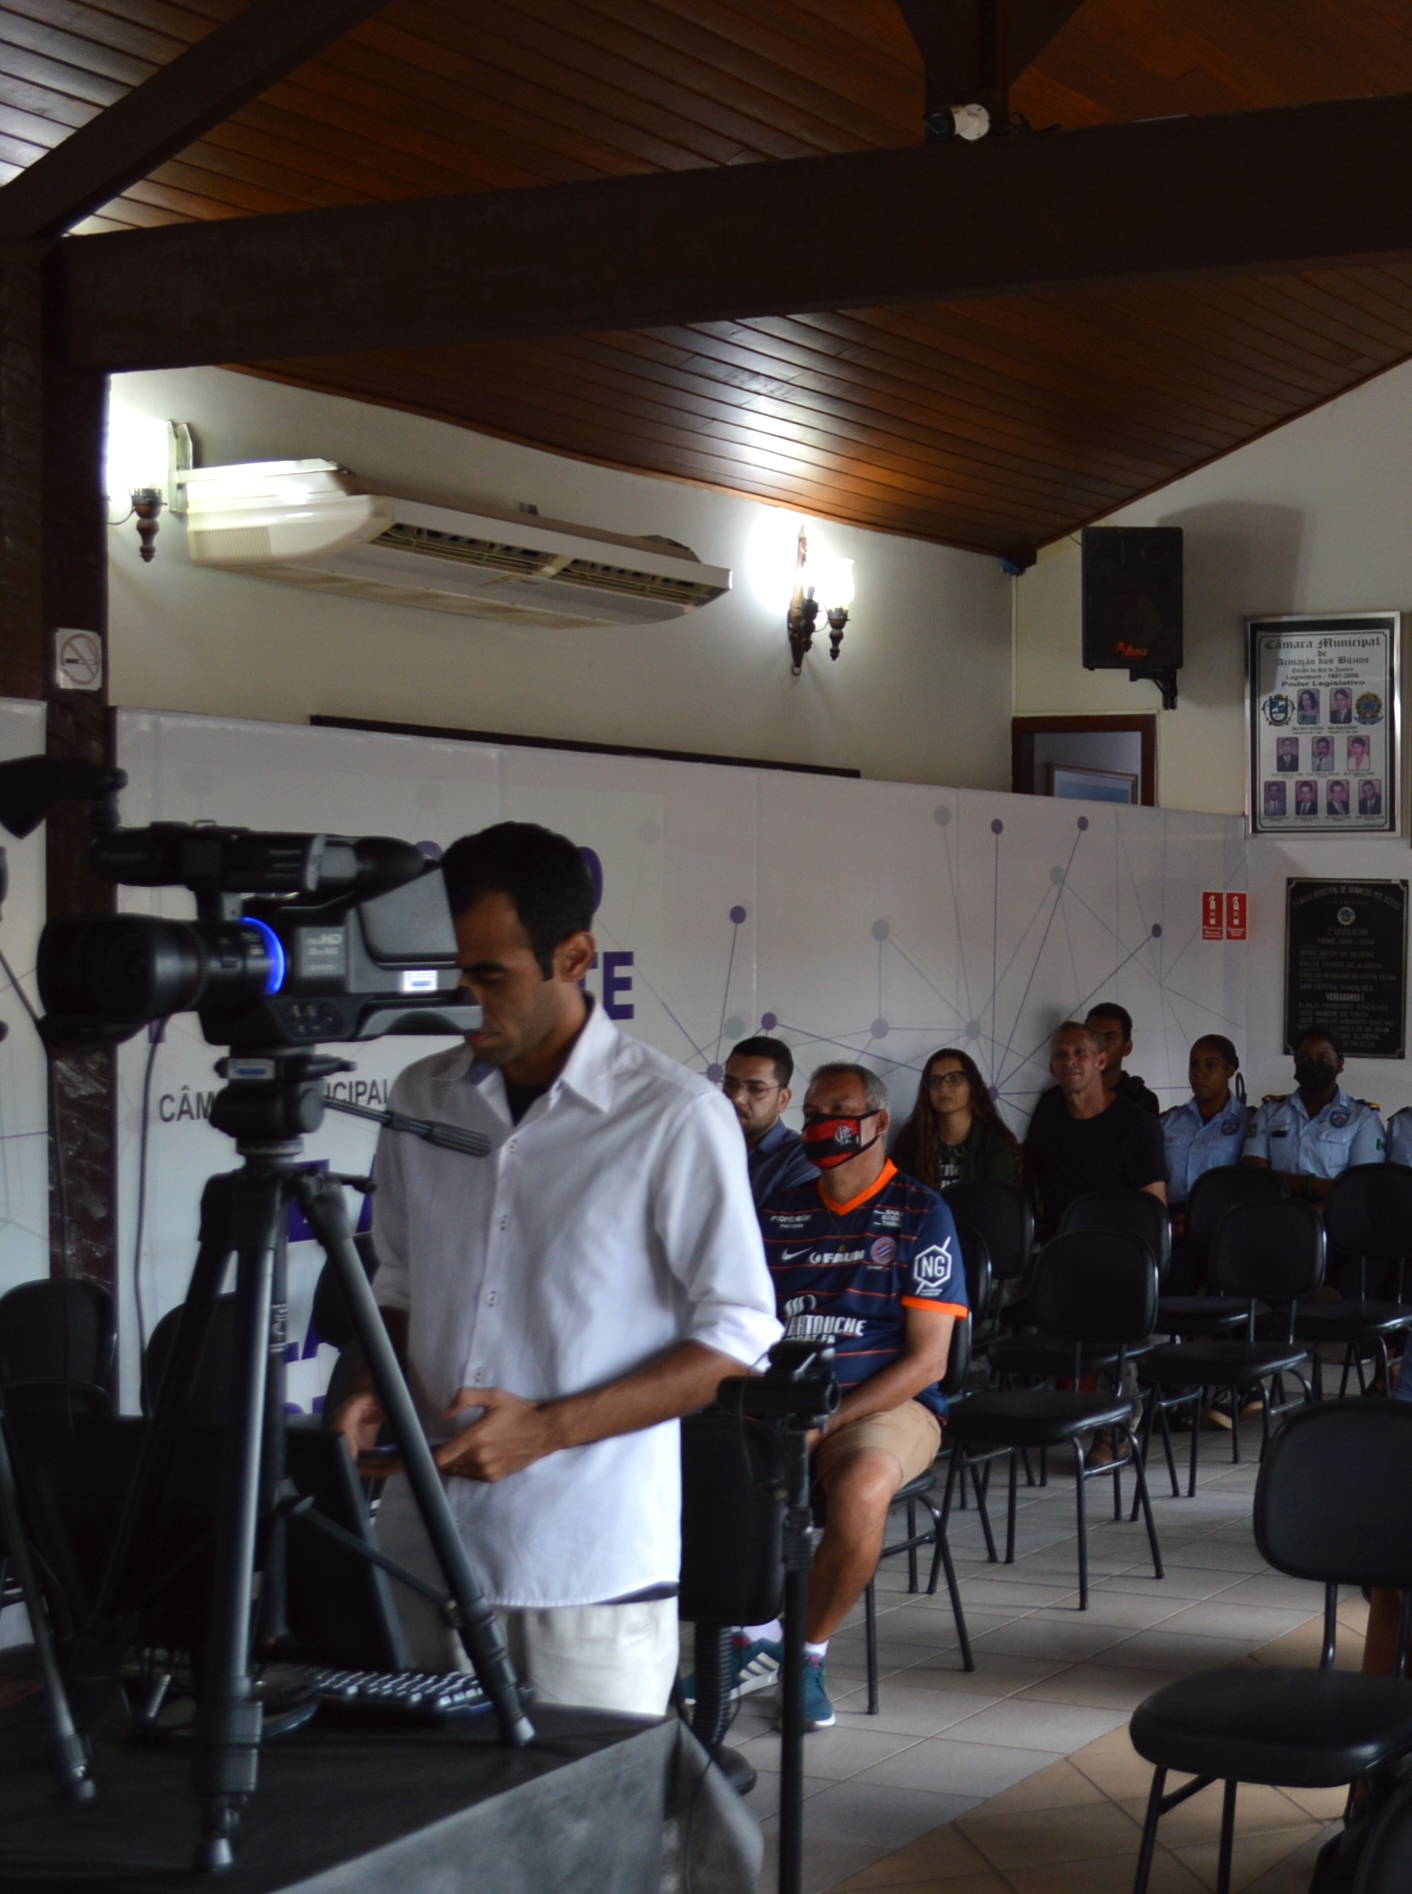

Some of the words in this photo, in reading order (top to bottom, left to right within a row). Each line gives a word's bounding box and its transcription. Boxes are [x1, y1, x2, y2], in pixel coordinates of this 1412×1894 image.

[1264, 640, 1312, 650] Câmara
[1317, 637, 1380, 649] Municipal
[1276, 658, 1315, 668] Armação
[1338, 656, 1370, 665] Búzios
[823, 1250, 866, 1264] FAUN
[921, 1256, 945, 1278] NG
[787, 1315, 867, 1336] ARTOUCHE
